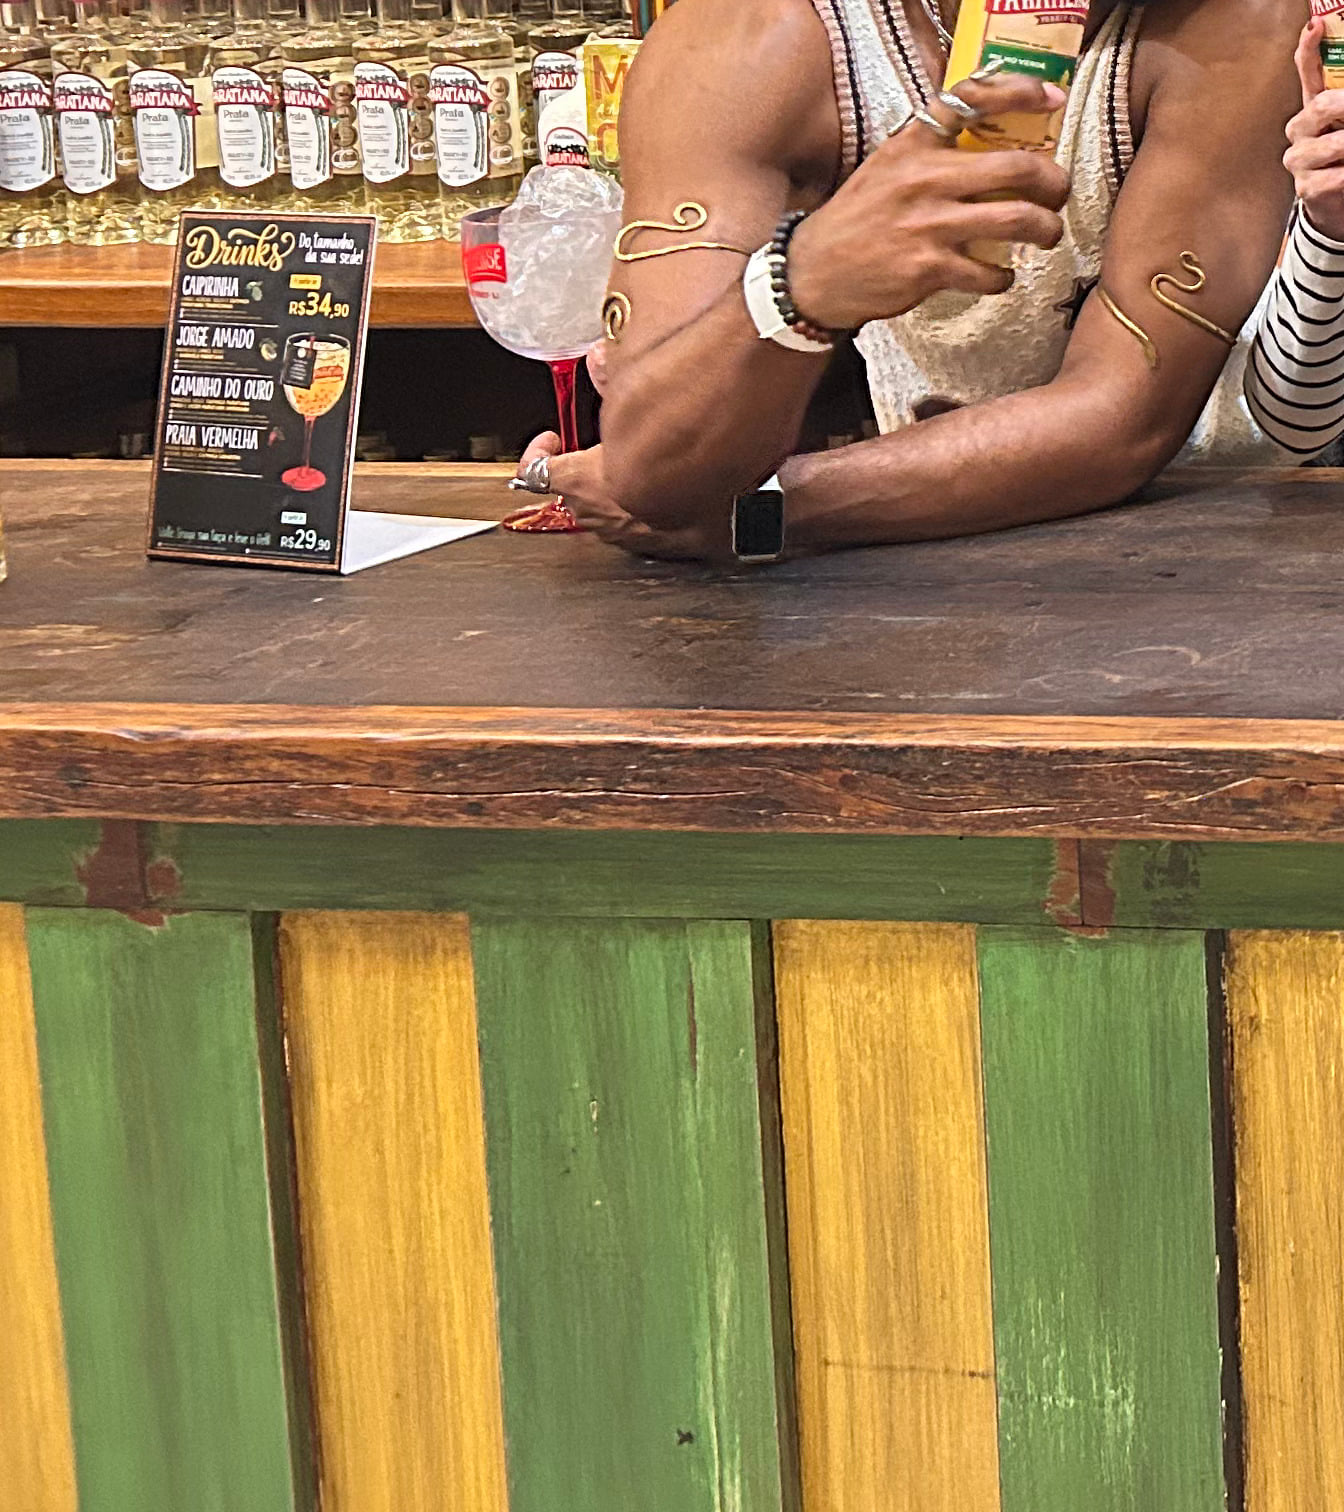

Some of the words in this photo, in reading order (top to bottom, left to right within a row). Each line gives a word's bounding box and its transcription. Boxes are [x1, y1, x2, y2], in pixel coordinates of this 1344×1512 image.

[186, 224, 295, 271] Drinks
[305, 247, 317, 263] da
[320, 252, 336, 263] sua
[182, 276, 239, 296] CAIPIRINHA
[288, 292, 349, 318] R$34,90
[176, 327, 209, 346] JORGE
[212, 328, 255, 348] AMADO
[171, 376, 221, 397] CAMINHO
[224, 378, 241, 397] DO
[244, 379, 274, 400] OURO
[165, 425, 196, 446] PRAIA
[202, 427, 258, 450] VERMELHA
[280, 529, 331, 551] R$29,90
